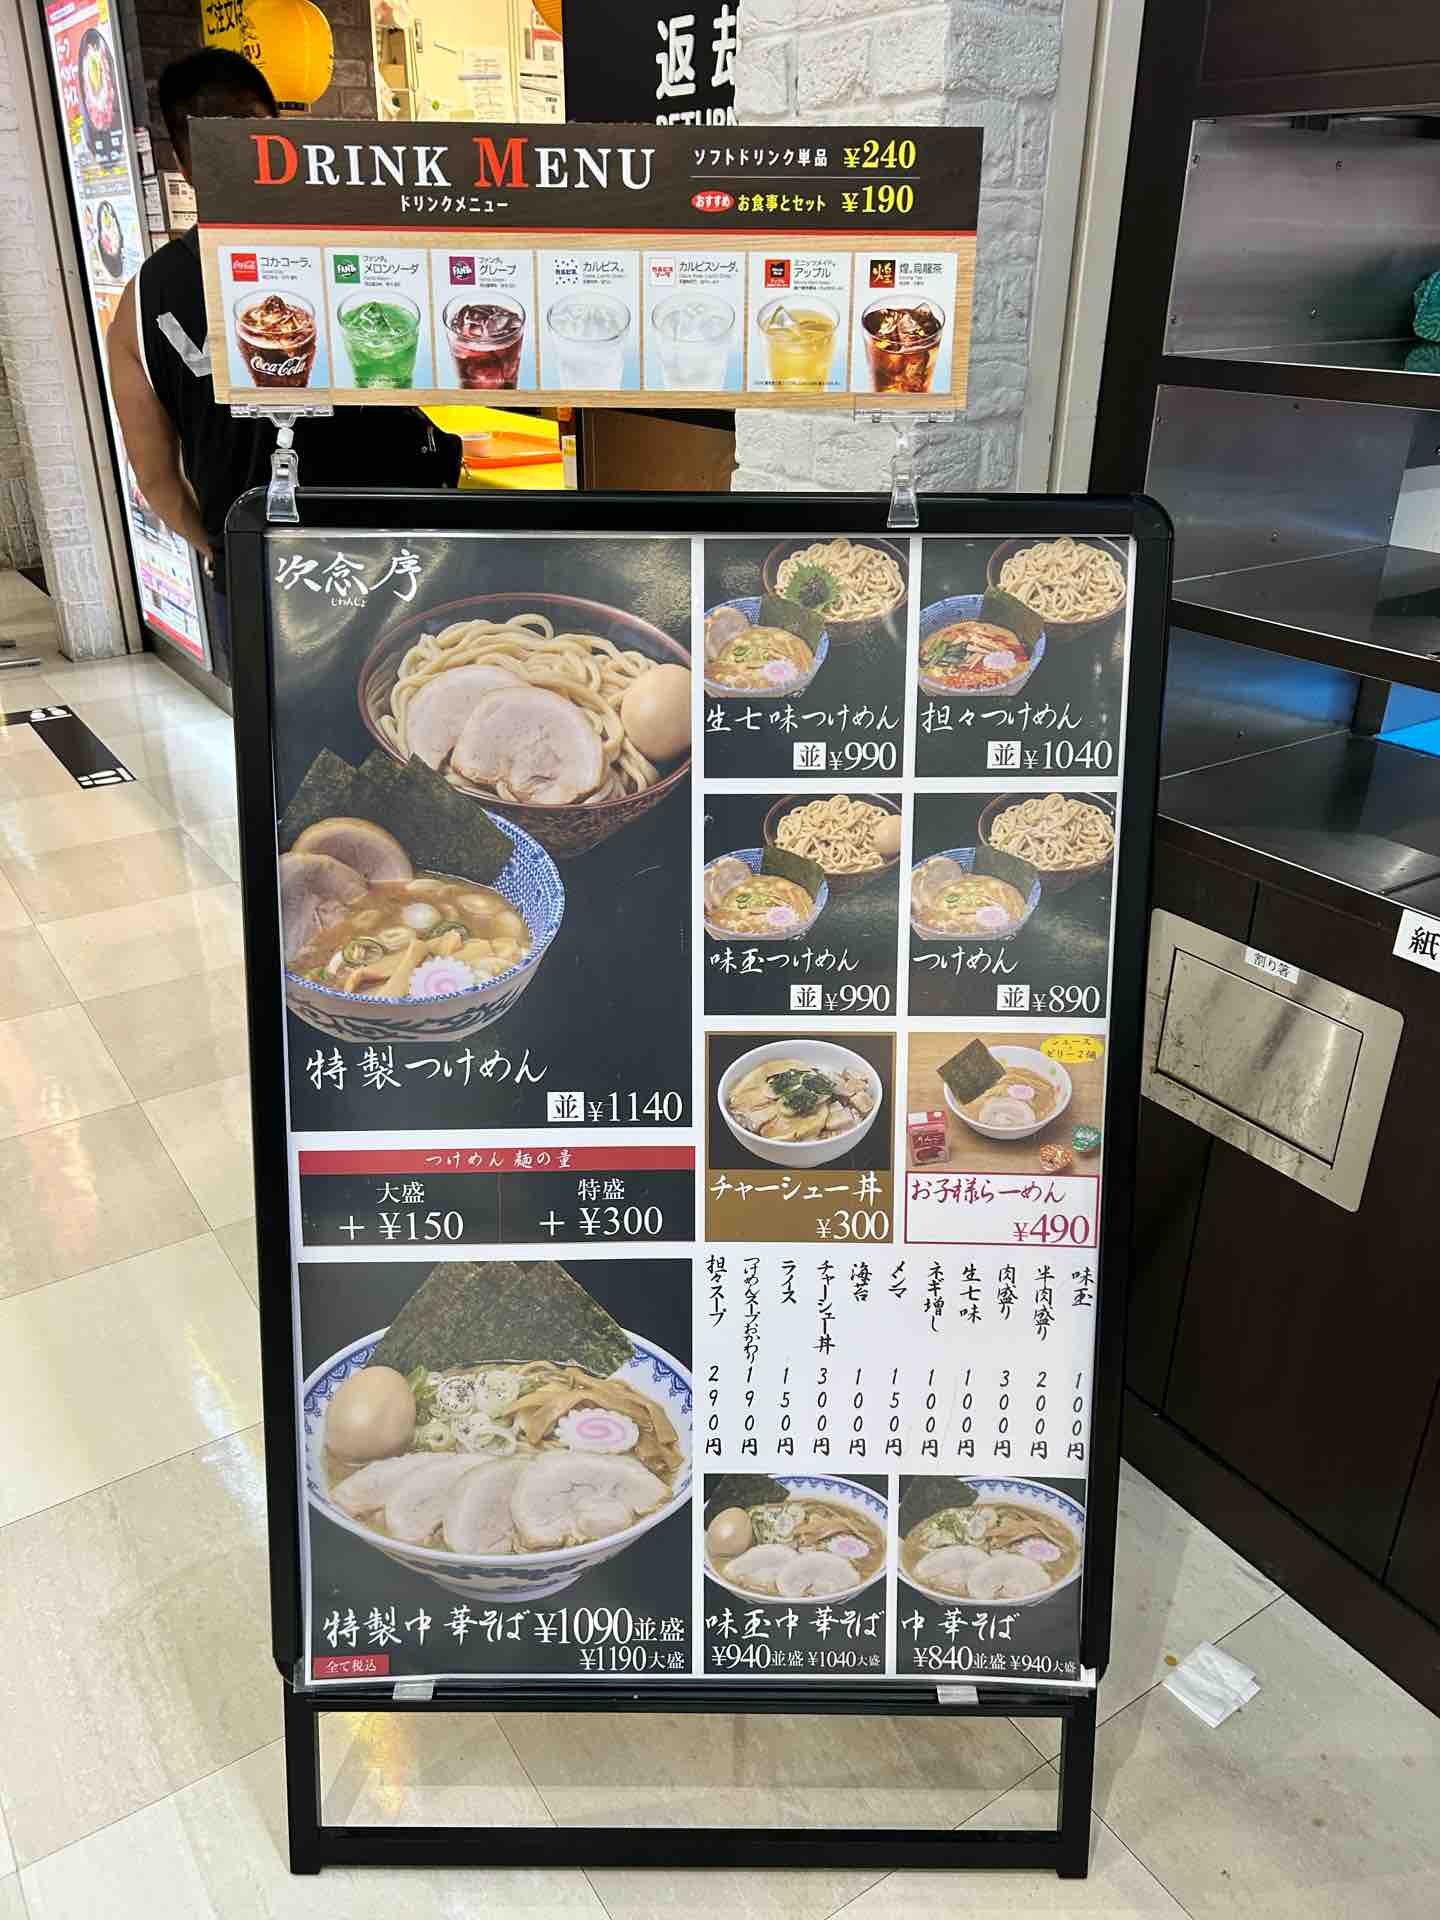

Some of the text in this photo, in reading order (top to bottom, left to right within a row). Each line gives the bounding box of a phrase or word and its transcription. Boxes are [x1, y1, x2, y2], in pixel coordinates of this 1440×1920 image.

[249, 134, 656, 189] DRINK MENU
[694, 140, 916, 169] ソフトドリンク単品 ¥240
[400, 195, 508, 213] ドリンクメニュー
[695, 184, 914, 213] おすすめ お食事とセット ¥190
[364, 263, 419, 275] メロンソーダ
[479, 263, 516, 275] グレープ
[583, 260, 620, 272] カルピス
[680, 260, 736, 273] カルピスソーダ
[794, 267, 832, 279] アップル
[275, 549, 422, 602] 次念序
[705, 703, 900, 734] 生七味つけめん
[920, 701, 1082, 734] 担々つけめん
[796, 741, 897, 771] 並 ¥990
[990, 740, 1113, 770] 並 ¥1040
[1408, 926, 1440, 961] 紙
[709, 947, 860, 975] 味玉つけめん
[912, 946, 1019, 976] つけめん
[1253, 952, 1292, 979] 割り箸
[793, 984, 891, 1012] 並 ¥990
[999, 984, 1101, 1014] 並 ¥890
[305, 1045, 549, 1091] 特製つけめん
[550, 1091, 684, 1123] 並 ¥1140
[424, 1151, 504, 1168] つけめん
[376, 1181, 425, 1204] 大盛
[577, 1178, 625, 1201] 特盛
[709, 1171, 883, 1206] チャーシュー丼
[911, 1177, 1067, 1205] お子様らーめん
[379, 1210, 464, 1242] ¥150
[579, 1206, 664, 1237] ¥300
[816, 1210, 890, 1241] ¥300
[1013, 1214, 1091, 1244] ¥490
[705, 1254, 727, 1456] 担々スープ 290円
[777, 1260, 797, 1456] ライス 150円
[812, 1260, 836, 1456] チャーシュー丼 300円
[849, 1262, 872, 1456] 海苔 100円
[921, 1262, 945, 1457] ネギ増し 100円
[958, 1263, 982, 1458] 生七味 100円
[994, 1264, 1018, 1458] 肉盛り 300円
[1030, 1265, 1055, 1460] 半肉盛り 200円
[1067, 1267, 1095, 1460] 味玉 100円
[741, 1366, 758, 1456] 190円
[885, 1368, 902, 1456] 150円
[322, 1605, 531, 1648] 特製中華そば
[705, 1605, 885, 1641] 味玉中華そば
[901, 1608, 1021, 1642] 中華そば
